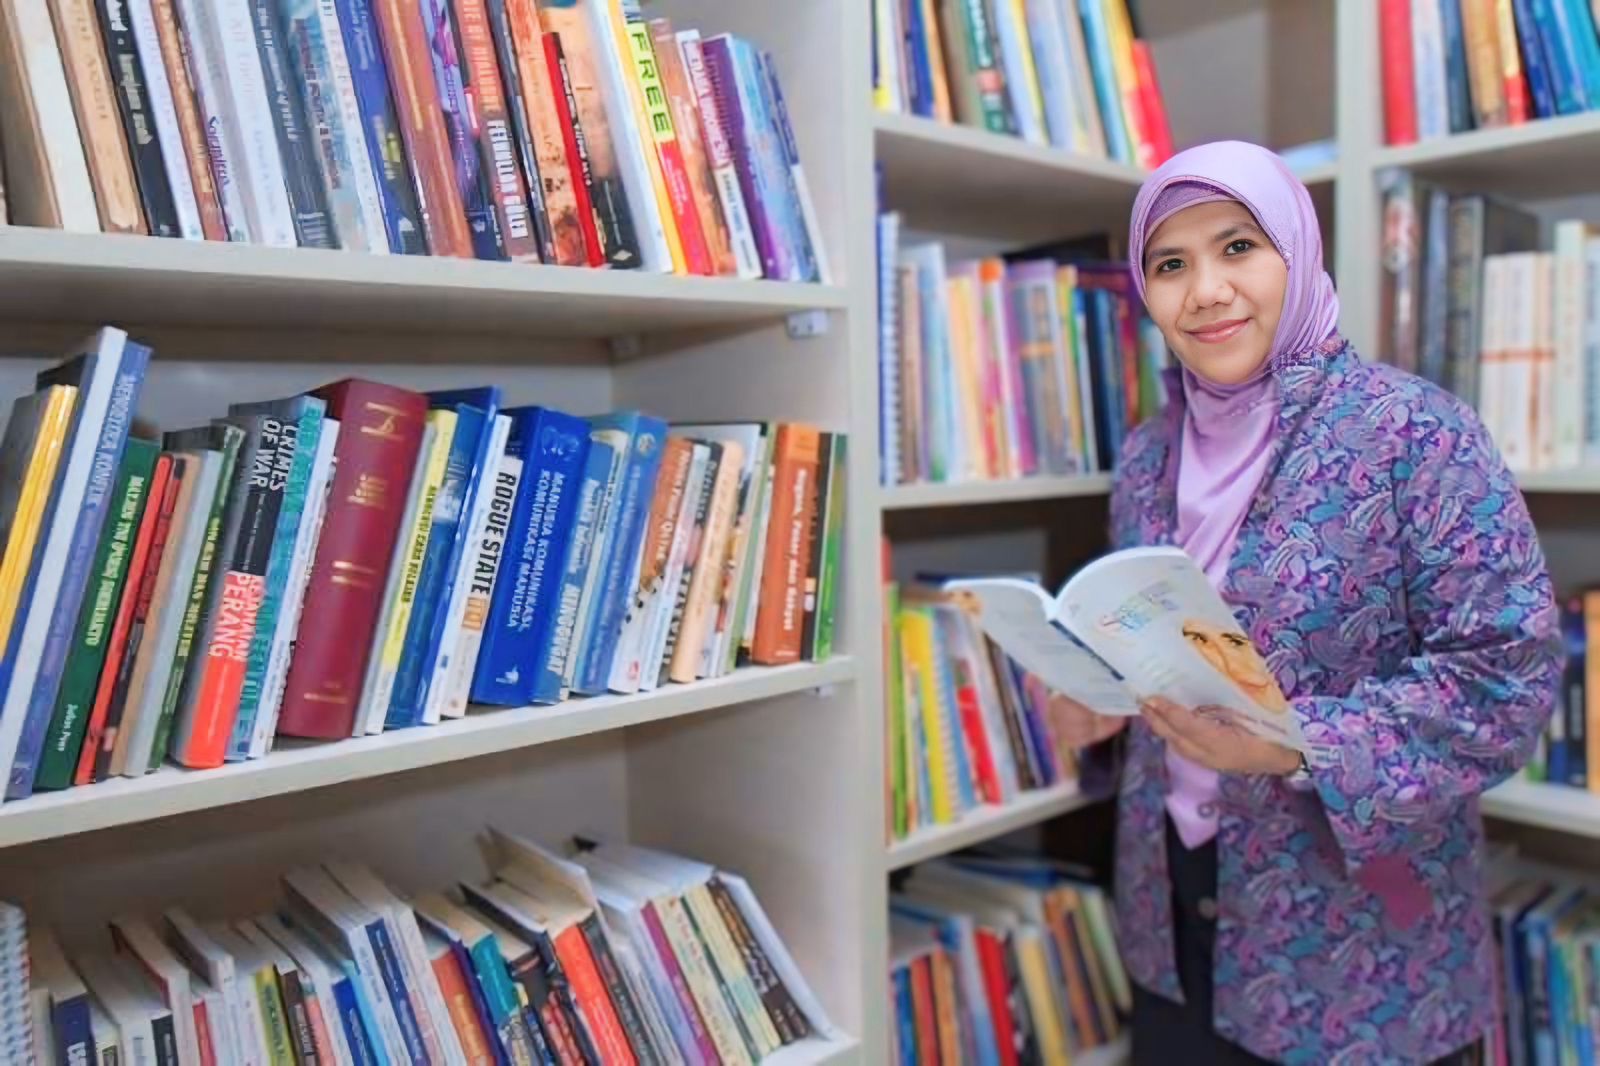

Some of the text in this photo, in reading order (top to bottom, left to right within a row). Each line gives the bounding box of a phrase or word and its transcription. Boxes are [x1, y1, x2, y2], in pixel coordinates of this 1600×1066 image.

[632, 32, 671, 132] FREE
[261, 419, 281, 444] OF
[269, 424, 298, 491] CRIMES
[247, 449, 275, 489] WAR
[470, 472, 516, 595] ROGUE STATE
[542, 471, 565, 537] MANUSIA
[208, 571, 249, 659] PERANG
